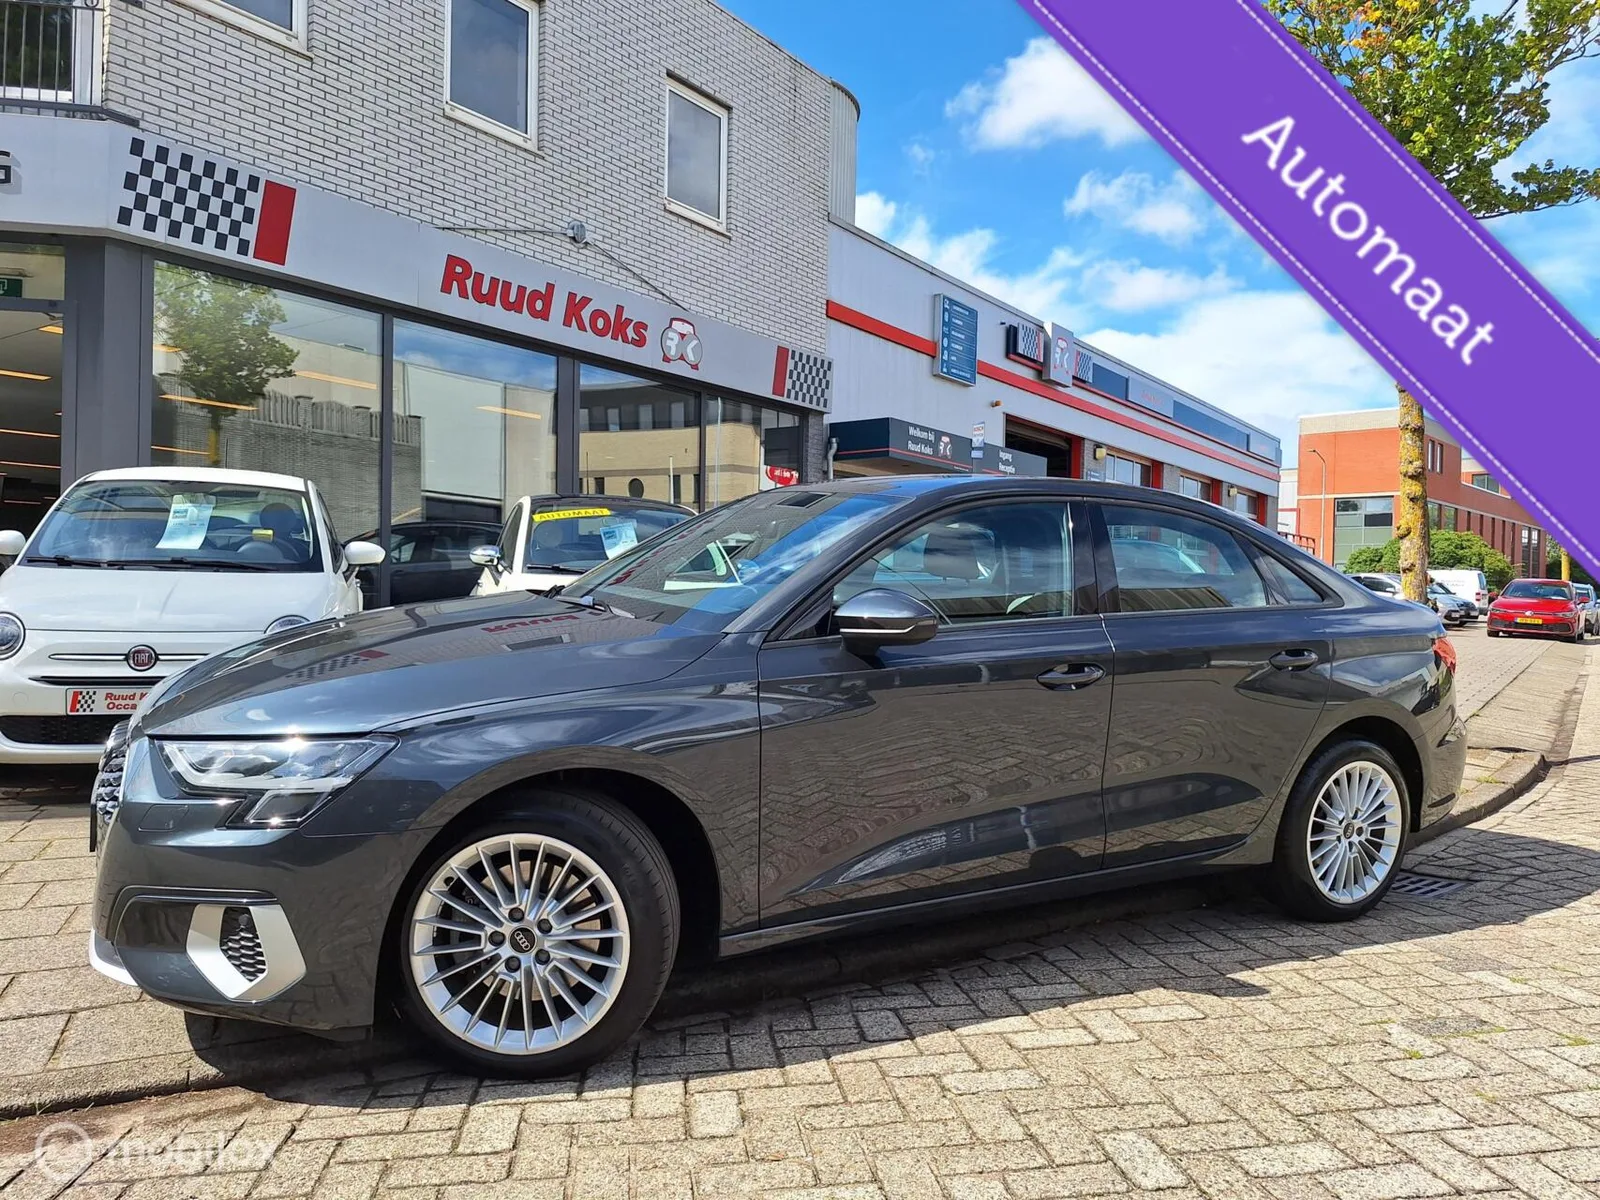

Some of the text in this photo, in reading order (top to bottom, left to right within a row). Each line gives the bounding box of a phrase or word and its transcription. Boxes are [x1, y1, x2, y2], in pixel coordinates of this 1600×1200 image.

[440, 254, 649, 348] Ruud Koks
[539, 509, 606, 520] AUTOMAAT
[134, 653, 149, 664] FIAT
[104, 692, 137, 701] Ruud
[106, 702, 137, 710] Occa
